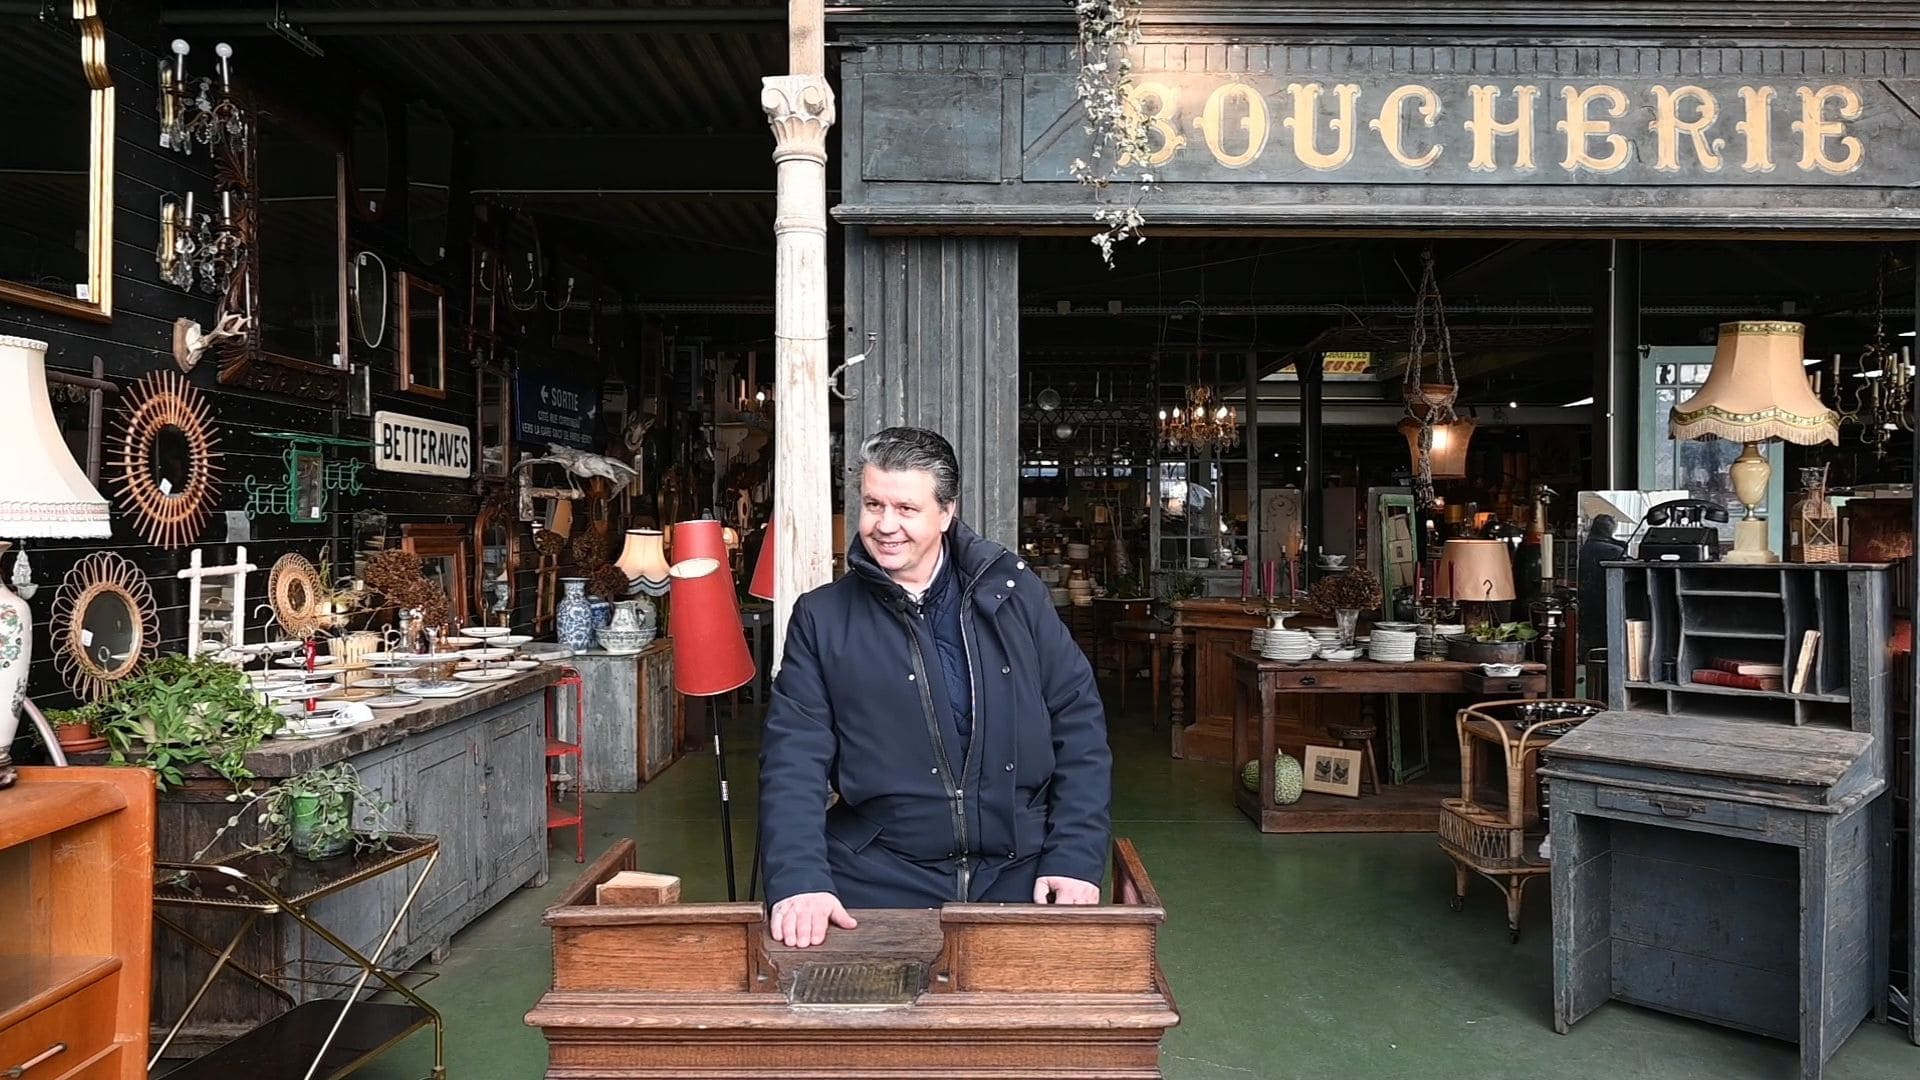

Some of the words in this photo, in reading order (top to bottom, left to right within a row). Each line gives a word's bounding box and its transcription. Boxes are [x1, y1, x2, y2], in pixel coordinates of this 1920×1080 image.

[1116, 83, 1867, 173] BOUCHERIE
[551, 387, 579, 412] SORTIE
[384, 423, 468, 468] BETTERAVES
